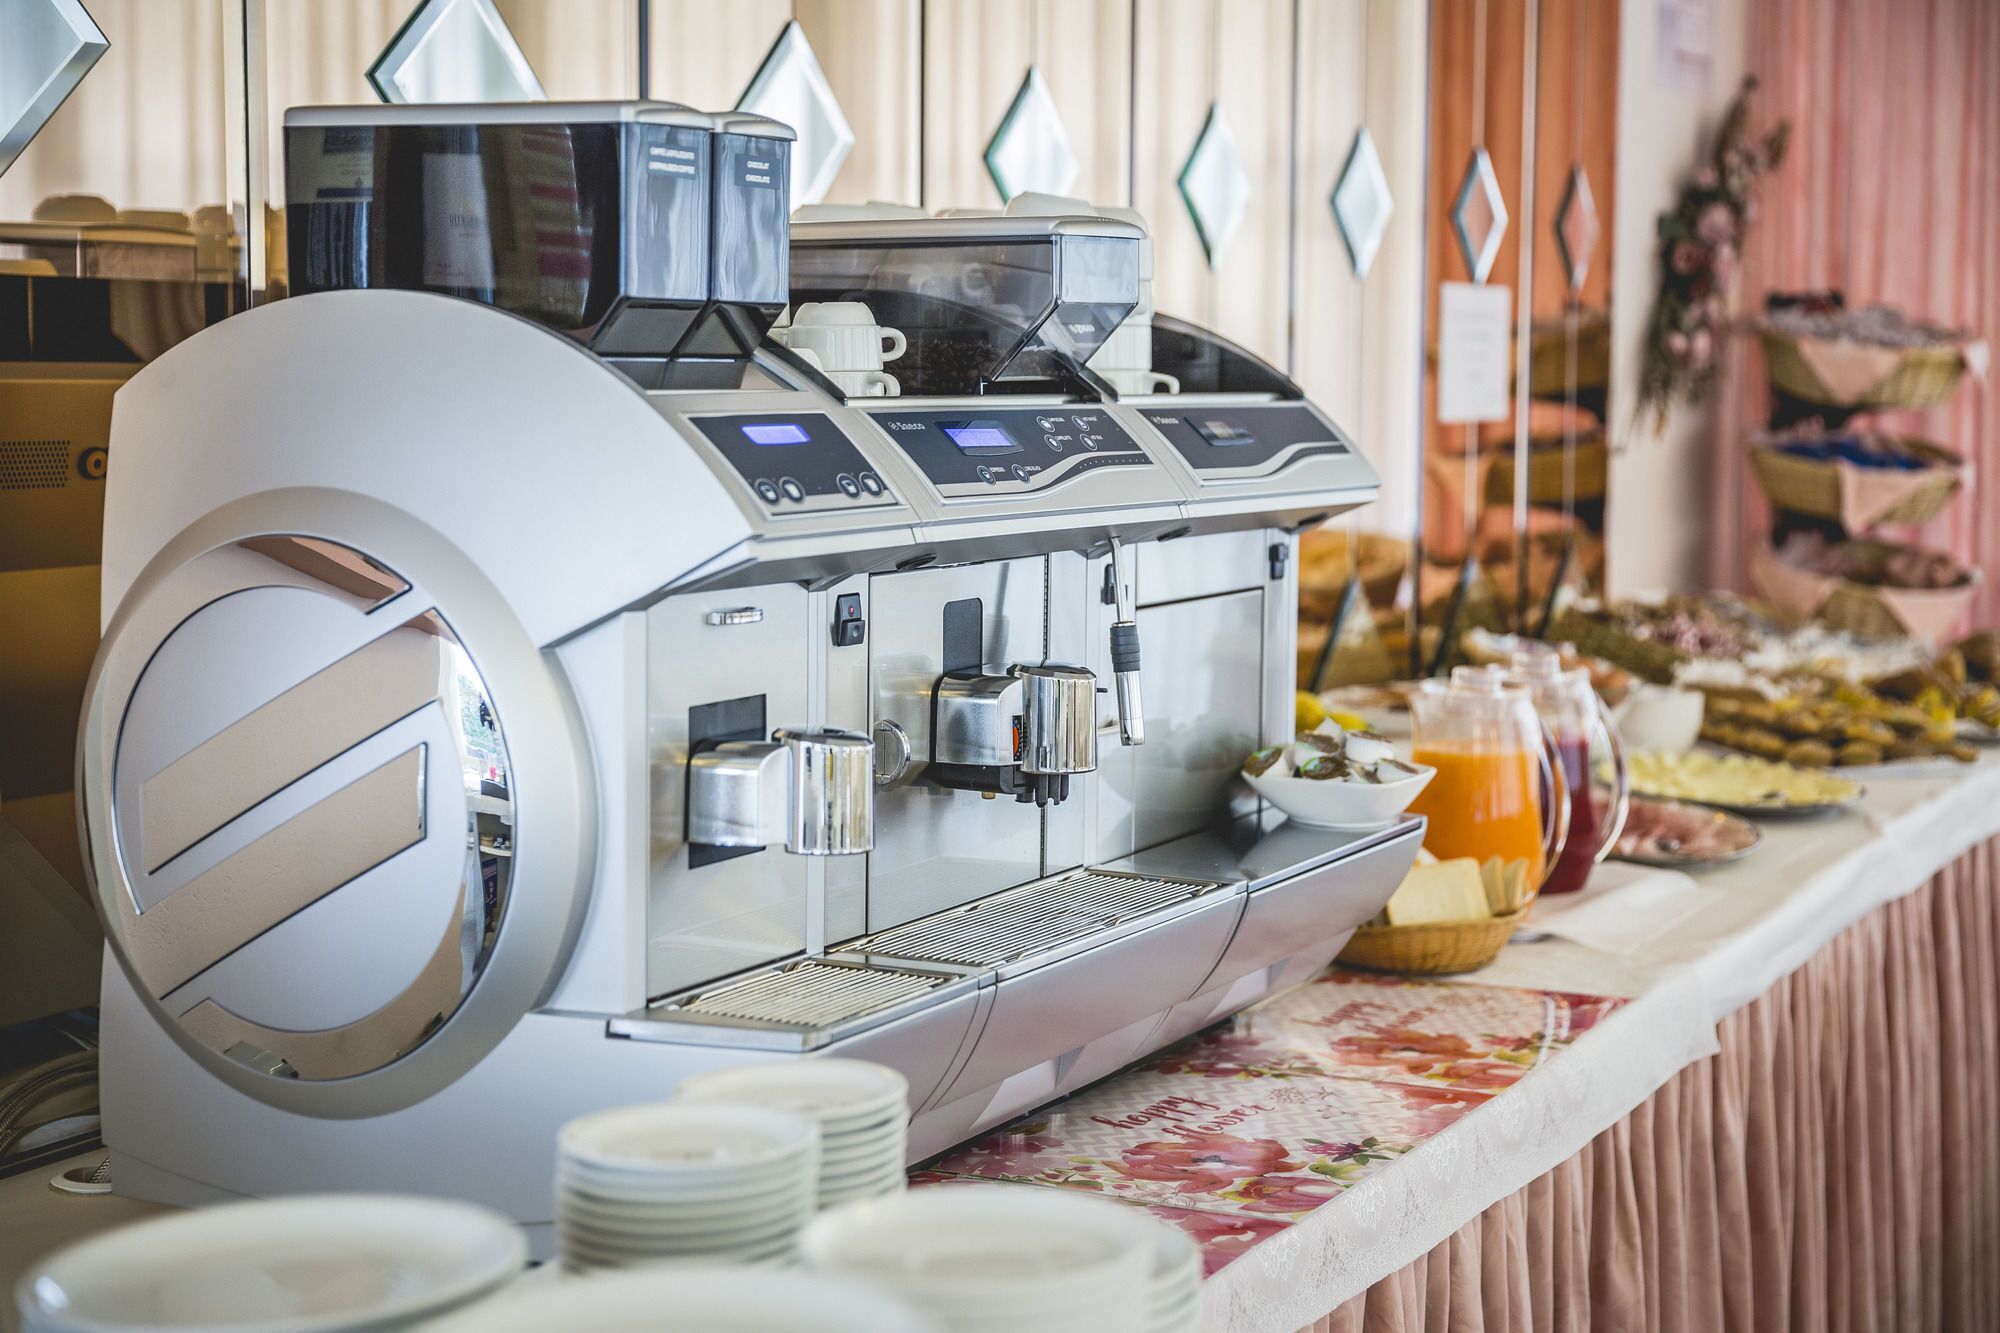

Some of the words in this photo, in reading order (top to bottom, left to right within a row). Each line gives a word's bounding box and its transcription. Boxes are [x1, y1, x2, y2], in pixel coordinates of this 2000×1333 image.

[747, 160, 770, 170] CHOCOLAT
[745, 173, 771, 184] CHOCOLATE
[895, 421, 926, 430] Saeco
[1090, 1095, 1220, 1130] happy
[1161, 1104, 1275, 1142] flower
